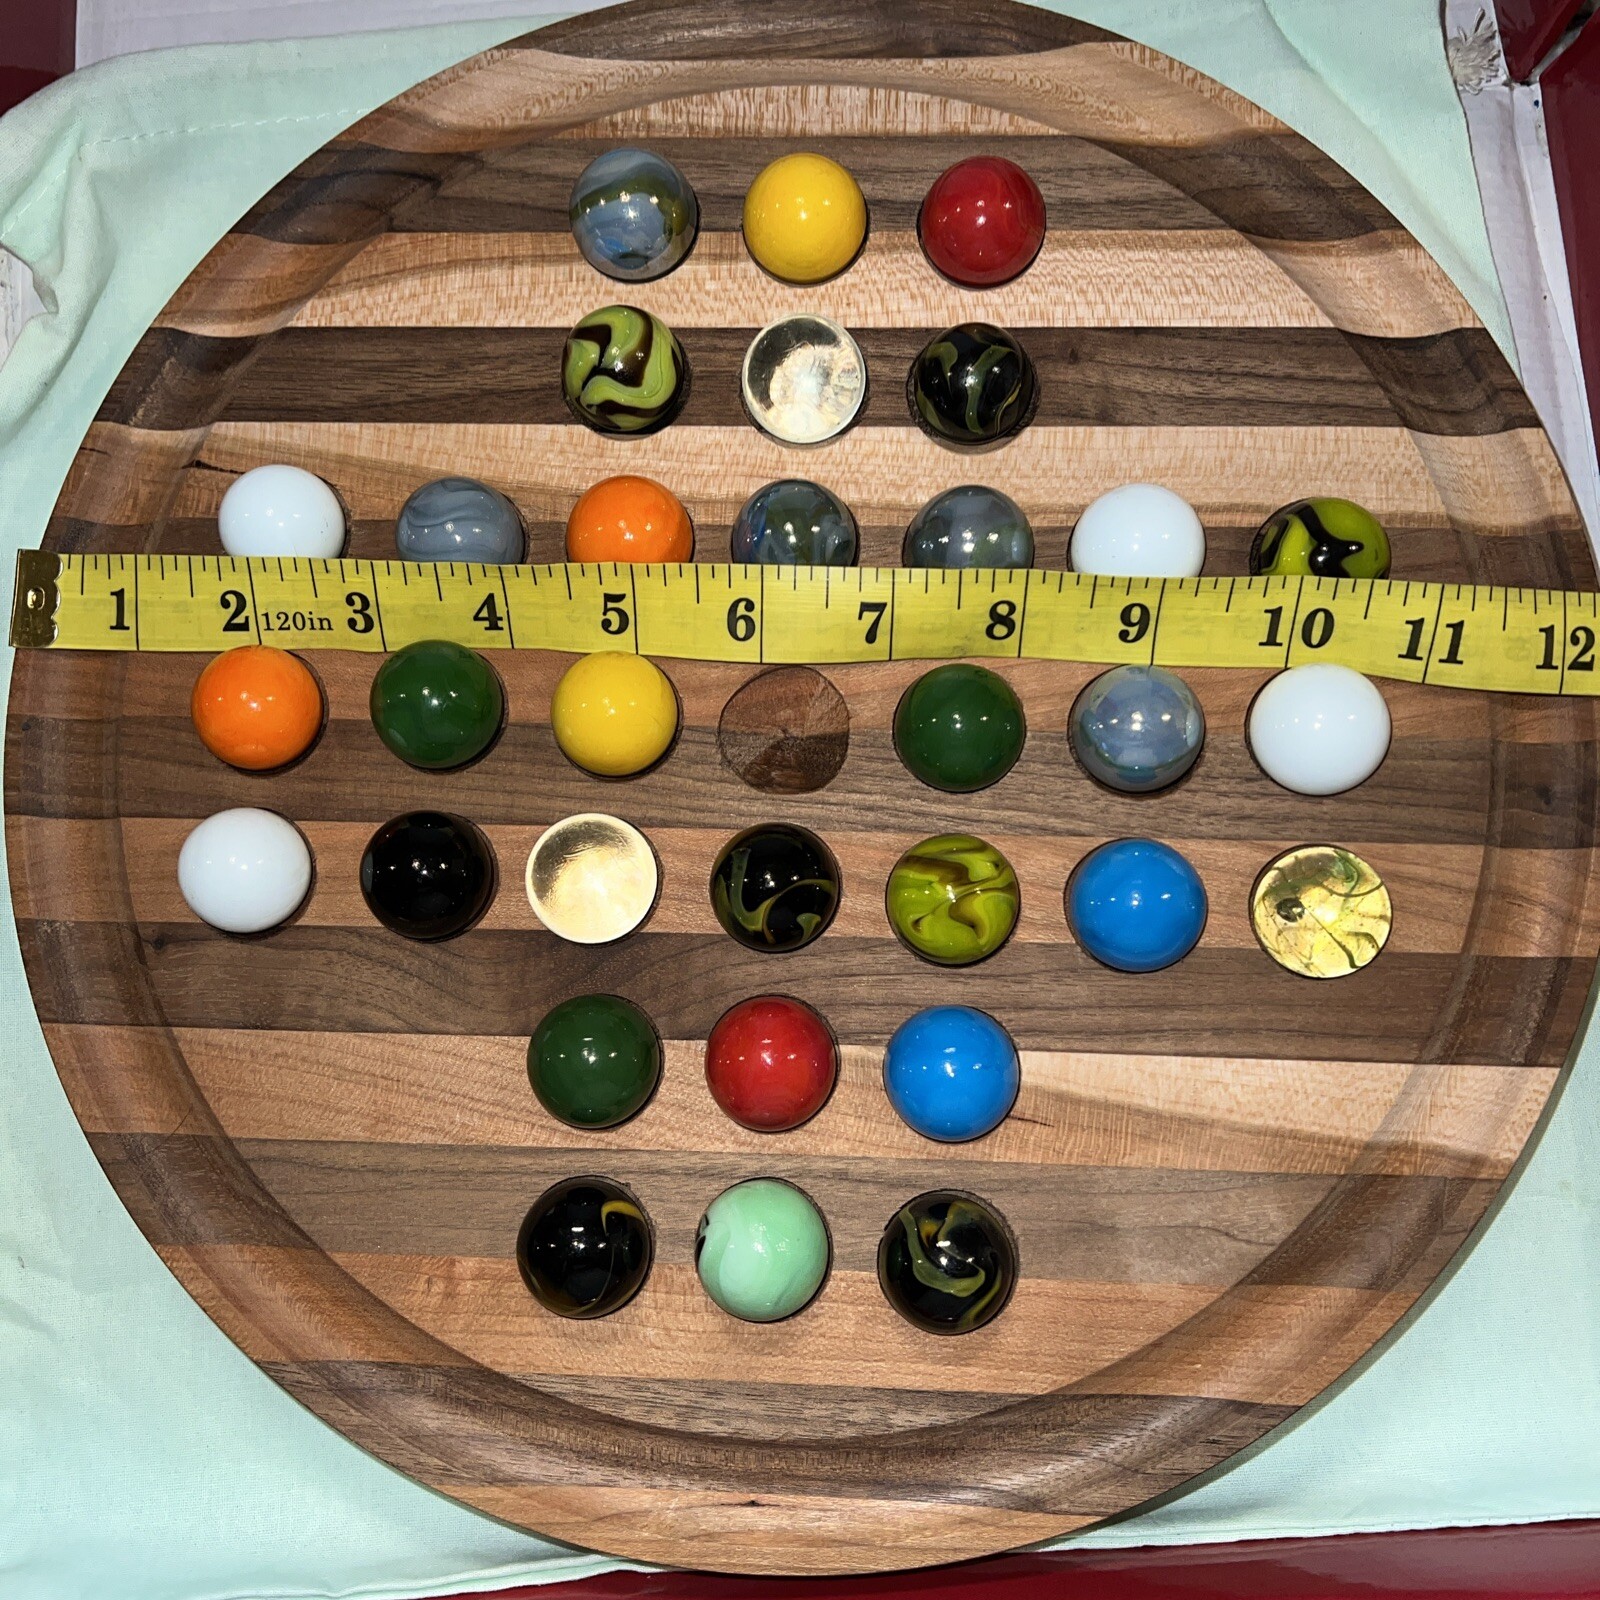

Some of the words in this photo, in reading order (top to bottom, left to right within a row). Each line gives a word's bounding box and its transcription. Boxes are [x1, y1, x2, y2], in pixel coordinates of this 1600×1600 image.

[109, 588, 131, 630] 1
[219, 590, 250, 632] 2
[262, 611, 334, 632] 120in
[345, 591, 375, 634] 3
[472, 592, 503, 631] 4
[600, 593, 630, 635] 5
[726, 597, 756, 642] 6
[857, 601, 888, 645] 7
[985, 600, 1017, 640] 8
[1118, 602, 1151, 643] 9
[1258, 606, 1335, 649] 10
[1397, 617, 1465, 665] 11
[1535, 624, 1595, 672] 12
